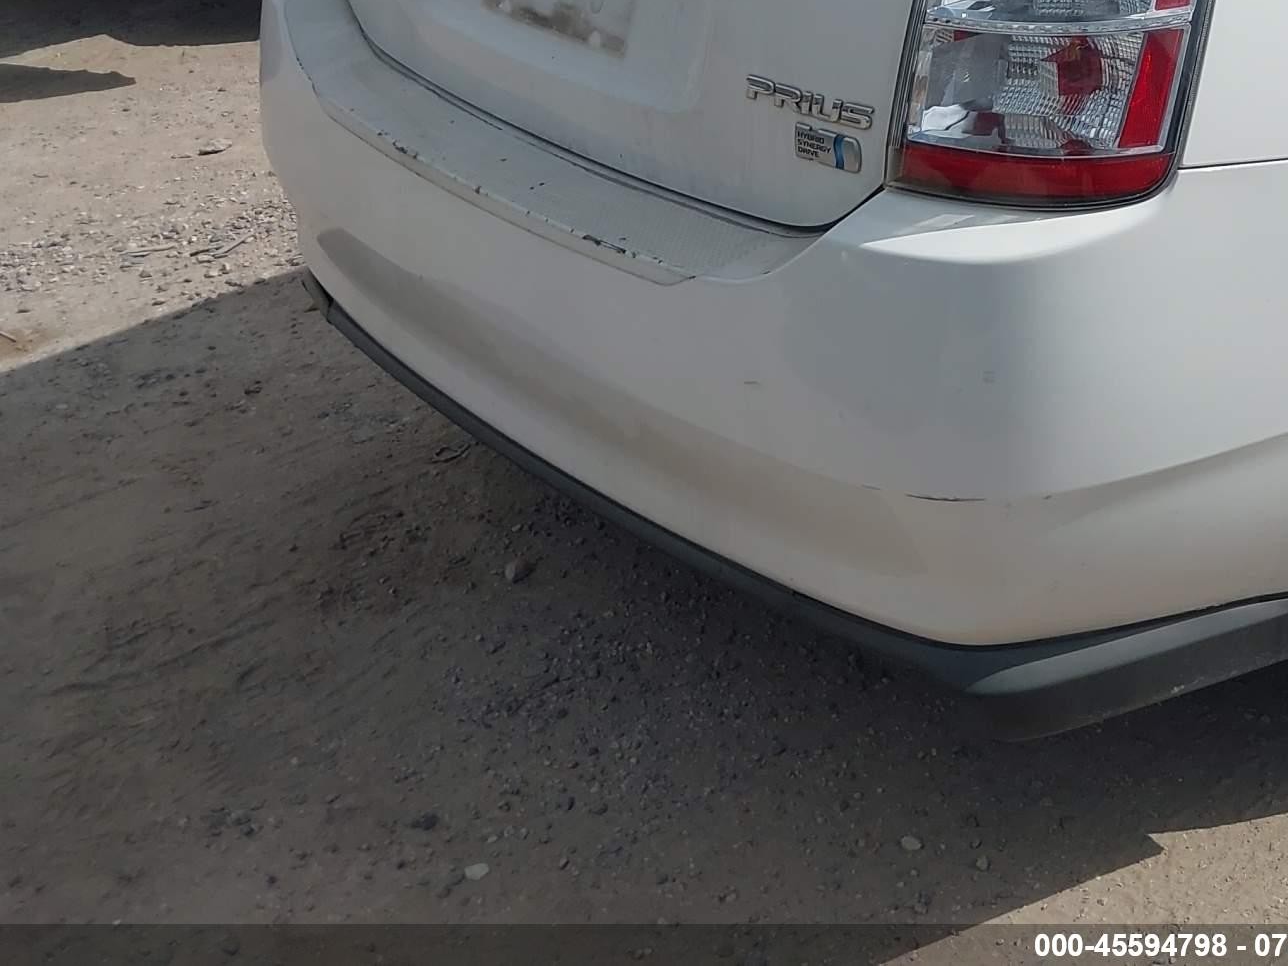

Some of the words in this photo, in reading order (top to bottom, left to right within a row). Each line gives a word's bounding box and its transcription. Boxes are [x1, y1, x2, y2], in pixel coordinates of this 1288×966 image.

[746, 74, 875, 130] PRIUS
[797, 131, 825, 144] HYBRID
[797, 138, 832, 153] SYNERGY
[797, 146, 820, 157] DRIVE
